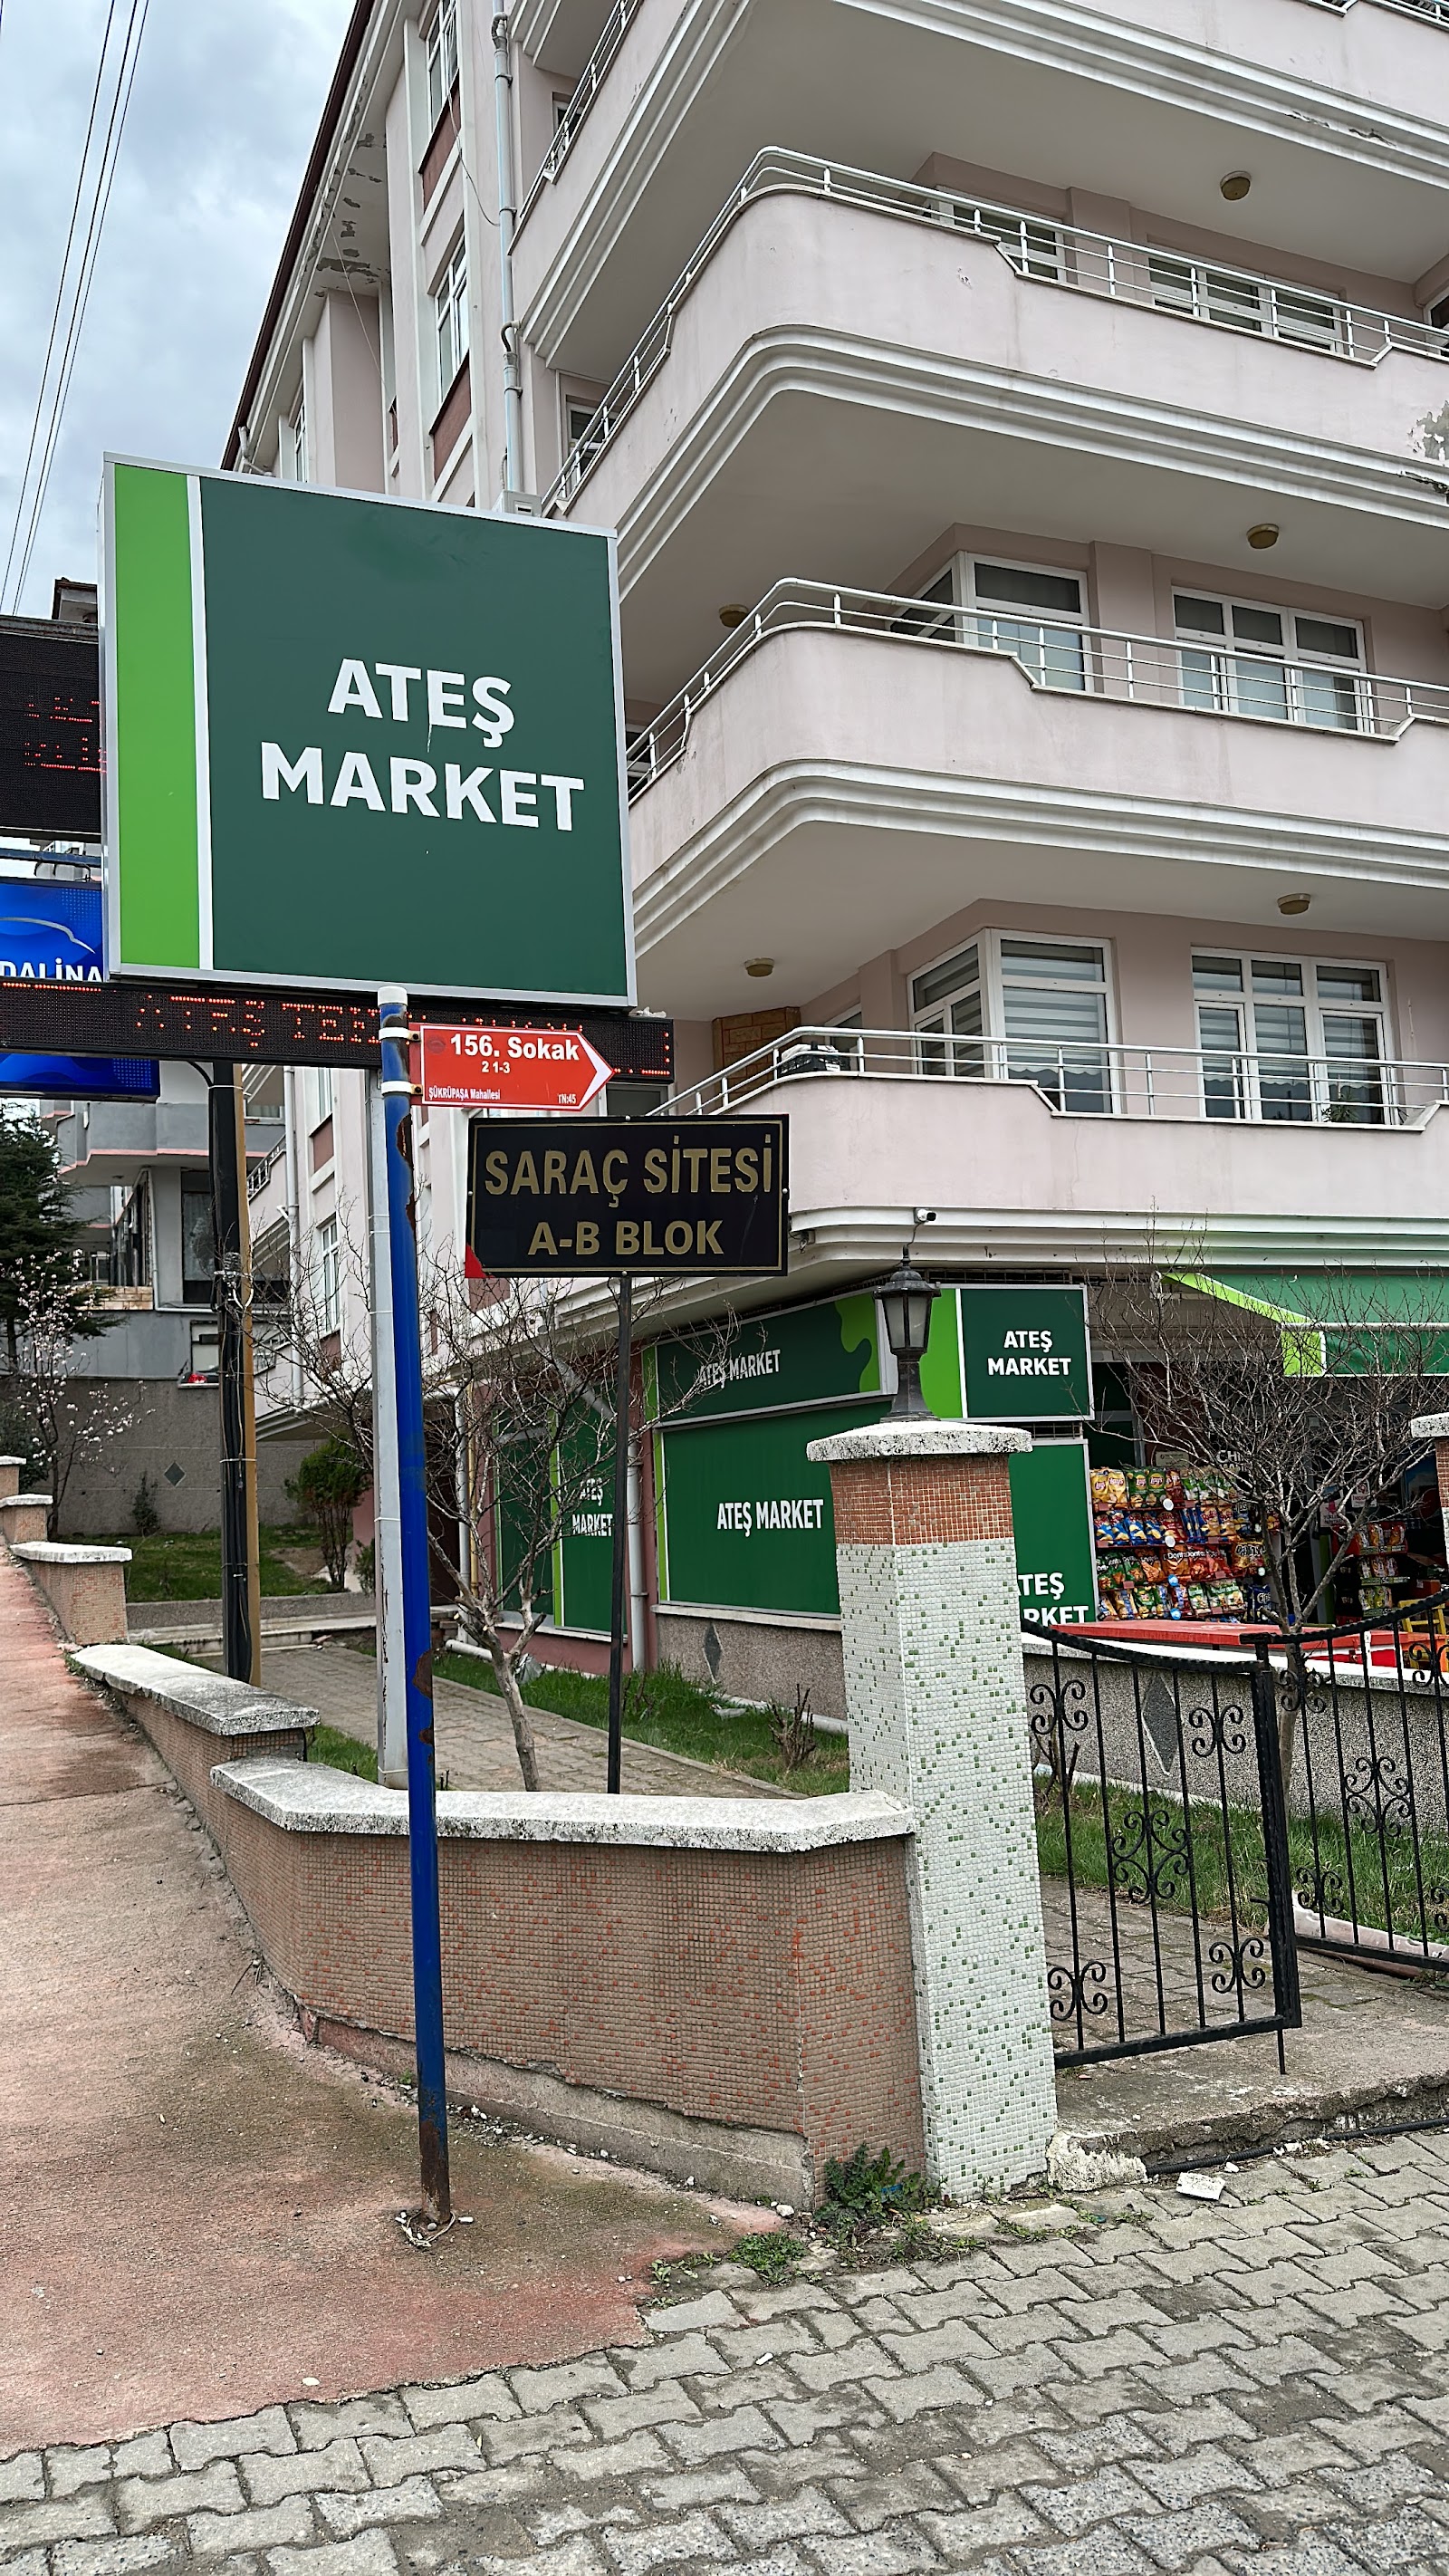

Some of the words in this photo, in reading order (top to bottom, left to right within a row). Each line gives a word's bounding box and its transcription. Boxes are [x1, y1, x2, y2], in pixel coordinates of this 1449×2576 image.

[328, 658, 515, 748] ATEŞ
[260, 741, 584, 831] MARKET
[450, 1033, 500, 1057] 156.
[507, 1036, 580, 1061] Sokak
[492, 1062, 511, 1073] 1-3
[470, 1089, 501, 1101] Mahallesi
[485, 1149, 629, 1207] SARAÇ
[644, 1133, 772, 1194] SİTESİ
[528, 1220, 600, 1255] A-B
[616, 1220, 724, 1254] BLOK
[1003, 1329, 1052, 1352] ATEŞ
[698, 1361, 726, 1389] ATEŞ
[729, 1349, 781, 1381] MARKET
[987, 1357, 1071, 1376] MARKET
[571, 1514, 613, 1537] MARKET
[716, 1501, 753, 1538] ATEŞ
[755, 1498, 823, 1530] MARKET
[1018, 1572, 1065, 1600] TEŞ
[1023, 1606, 1089, 1627] RKET
